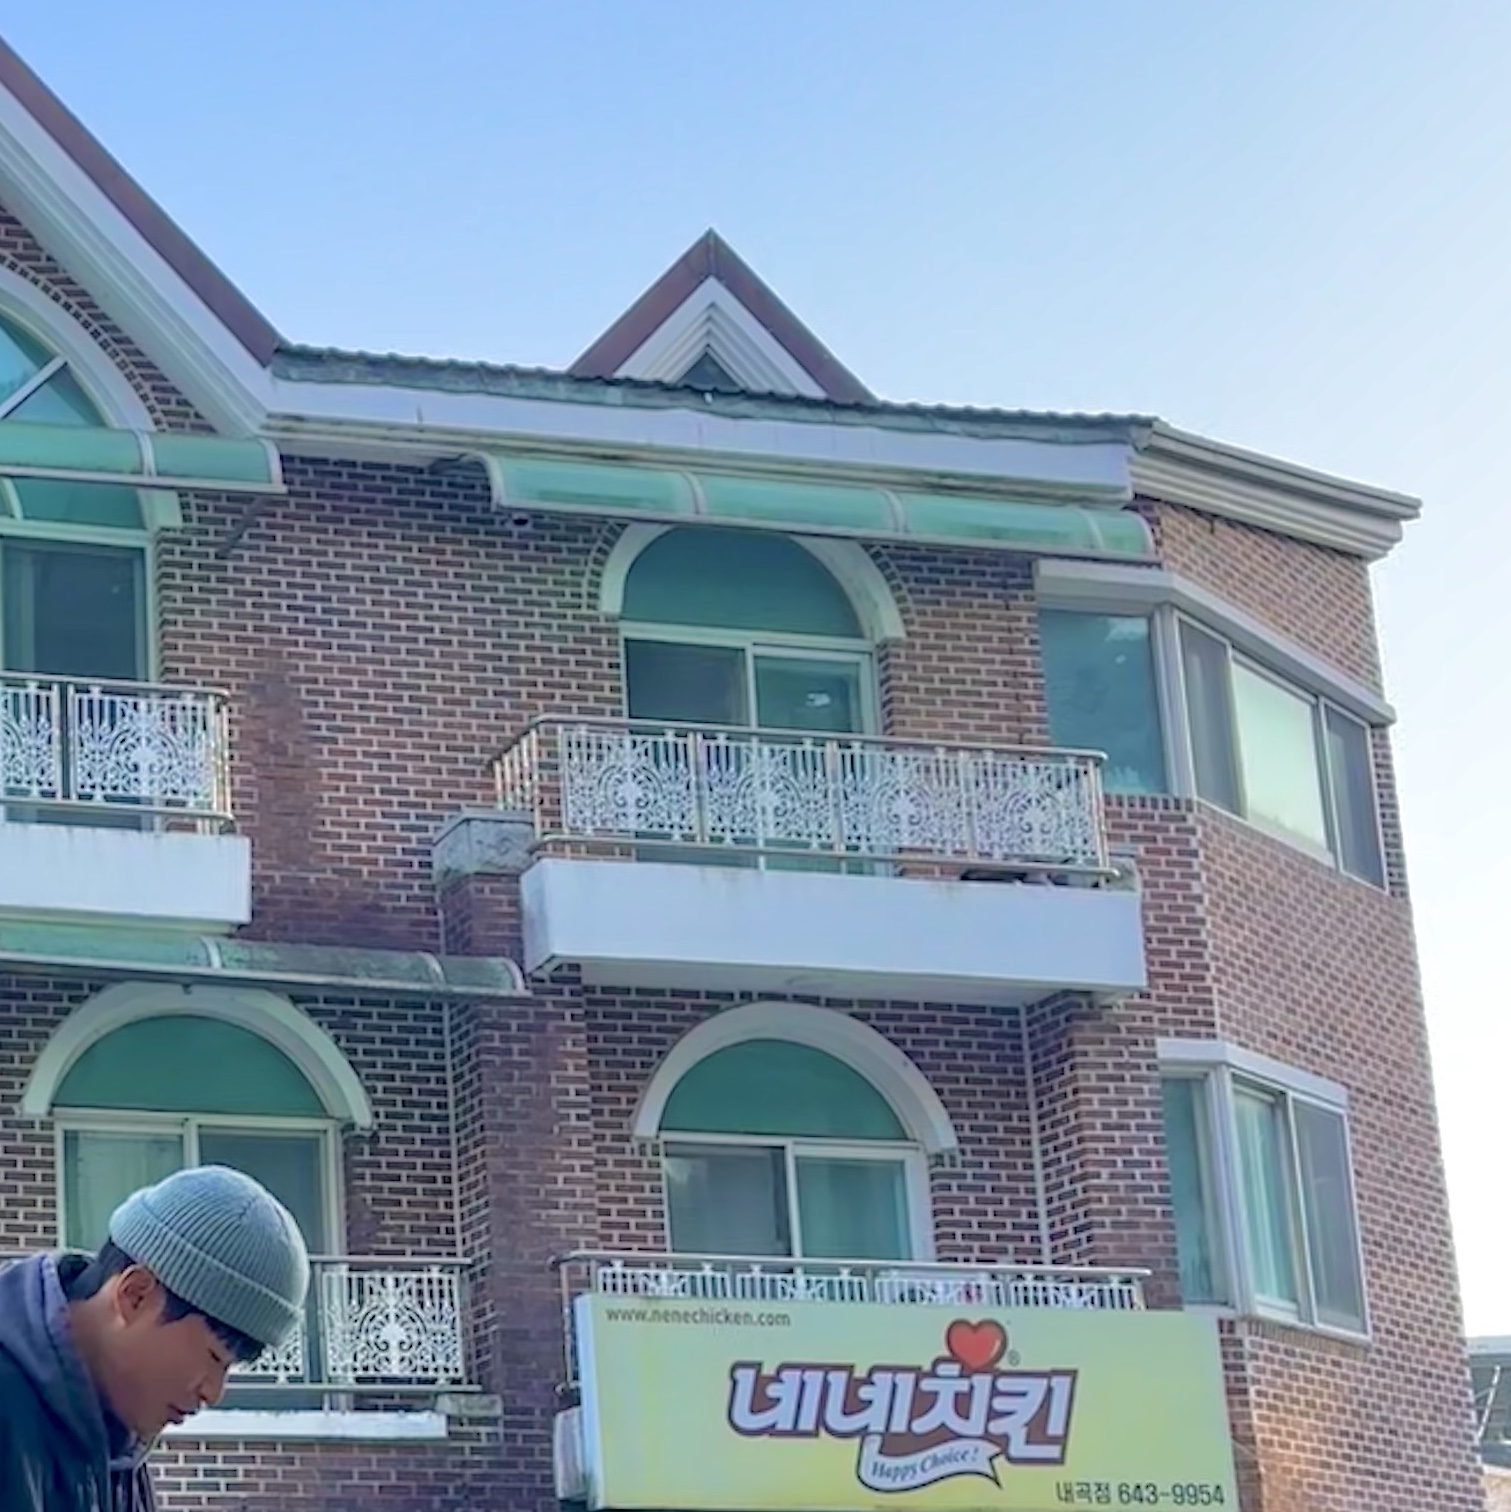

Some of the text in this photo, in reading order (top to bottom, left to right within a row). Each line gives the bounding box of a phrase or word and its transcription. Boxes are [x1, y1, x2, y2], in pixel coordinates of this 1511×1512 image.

[605, 1308, 791, 1326] www.nenechicken.com
[729, 1359, 1076, 1462] 네네치킨
[871, 1461, 918, 1482] Happy
[1056, 1481, 1225, 1506] 내곡점 643-9954
